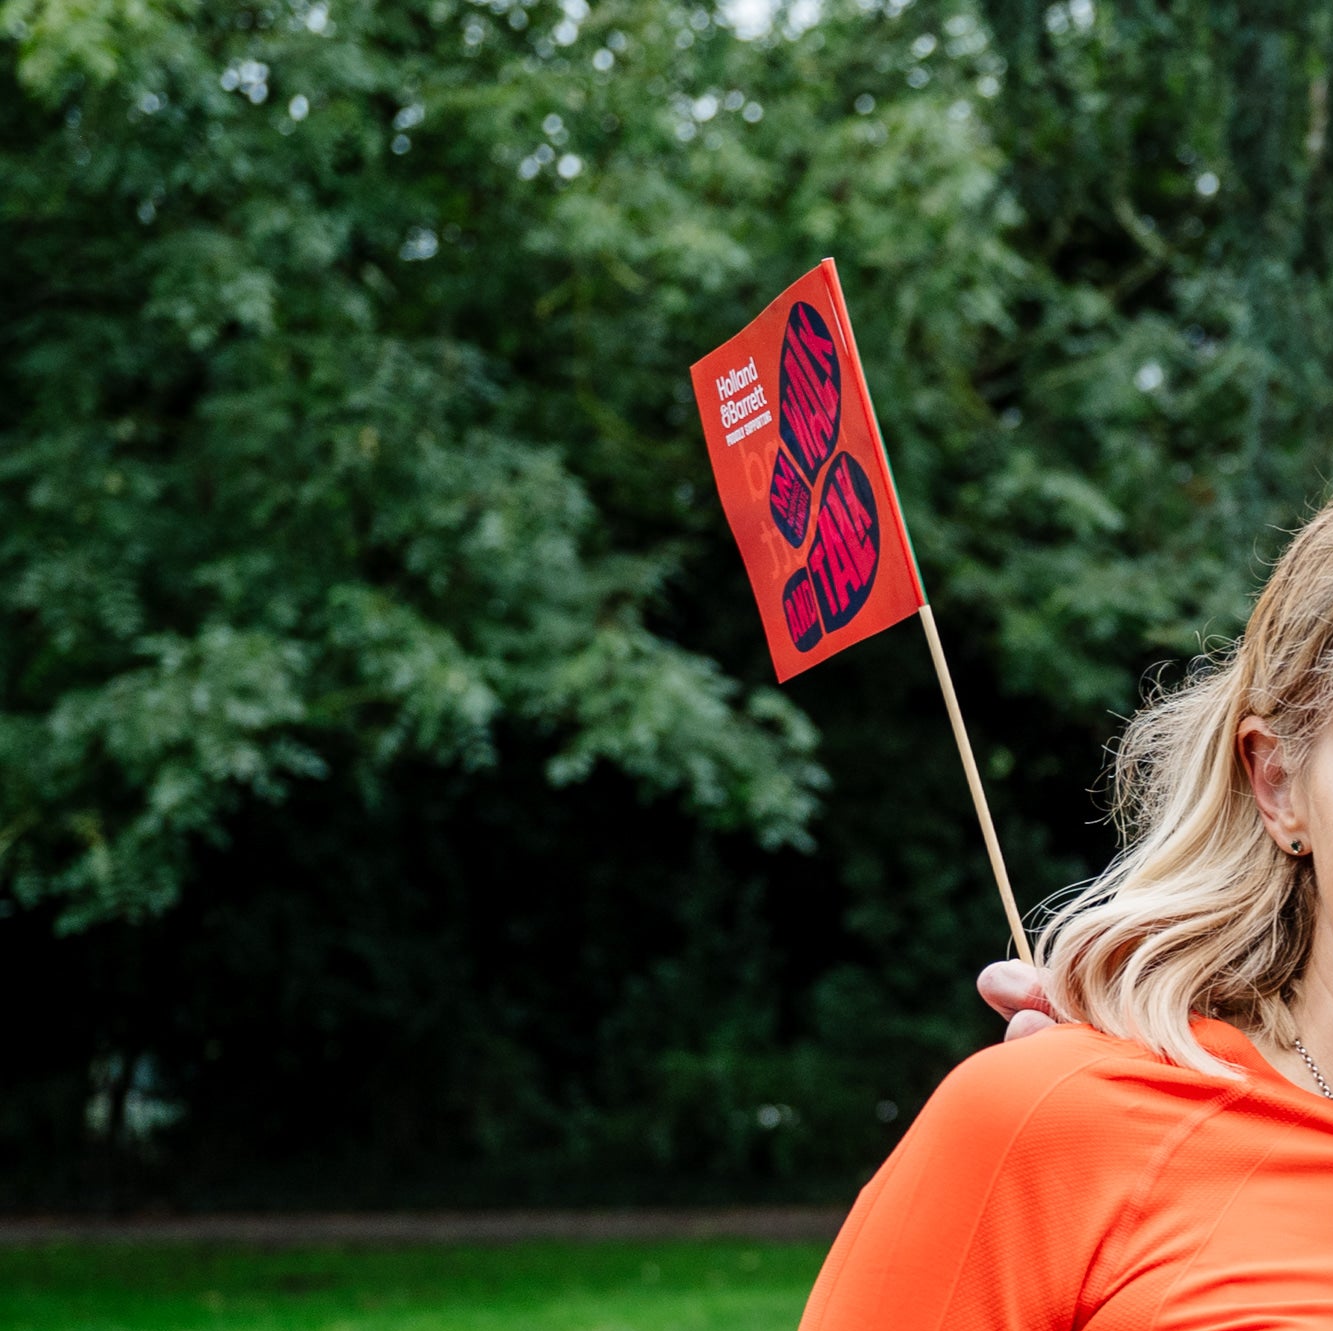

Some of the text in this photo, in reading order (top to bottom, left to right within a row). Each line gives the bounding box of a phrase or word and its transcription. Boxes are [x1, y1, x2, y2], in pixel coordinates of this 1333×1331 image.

[716, 356, 758, 401] Holland
[720, 384, 768, 428] &Barrett
[782, 303, 839, 469] WALK
[809, 453, 877, 616] TALK
[784, 579, 817, 643] AND
